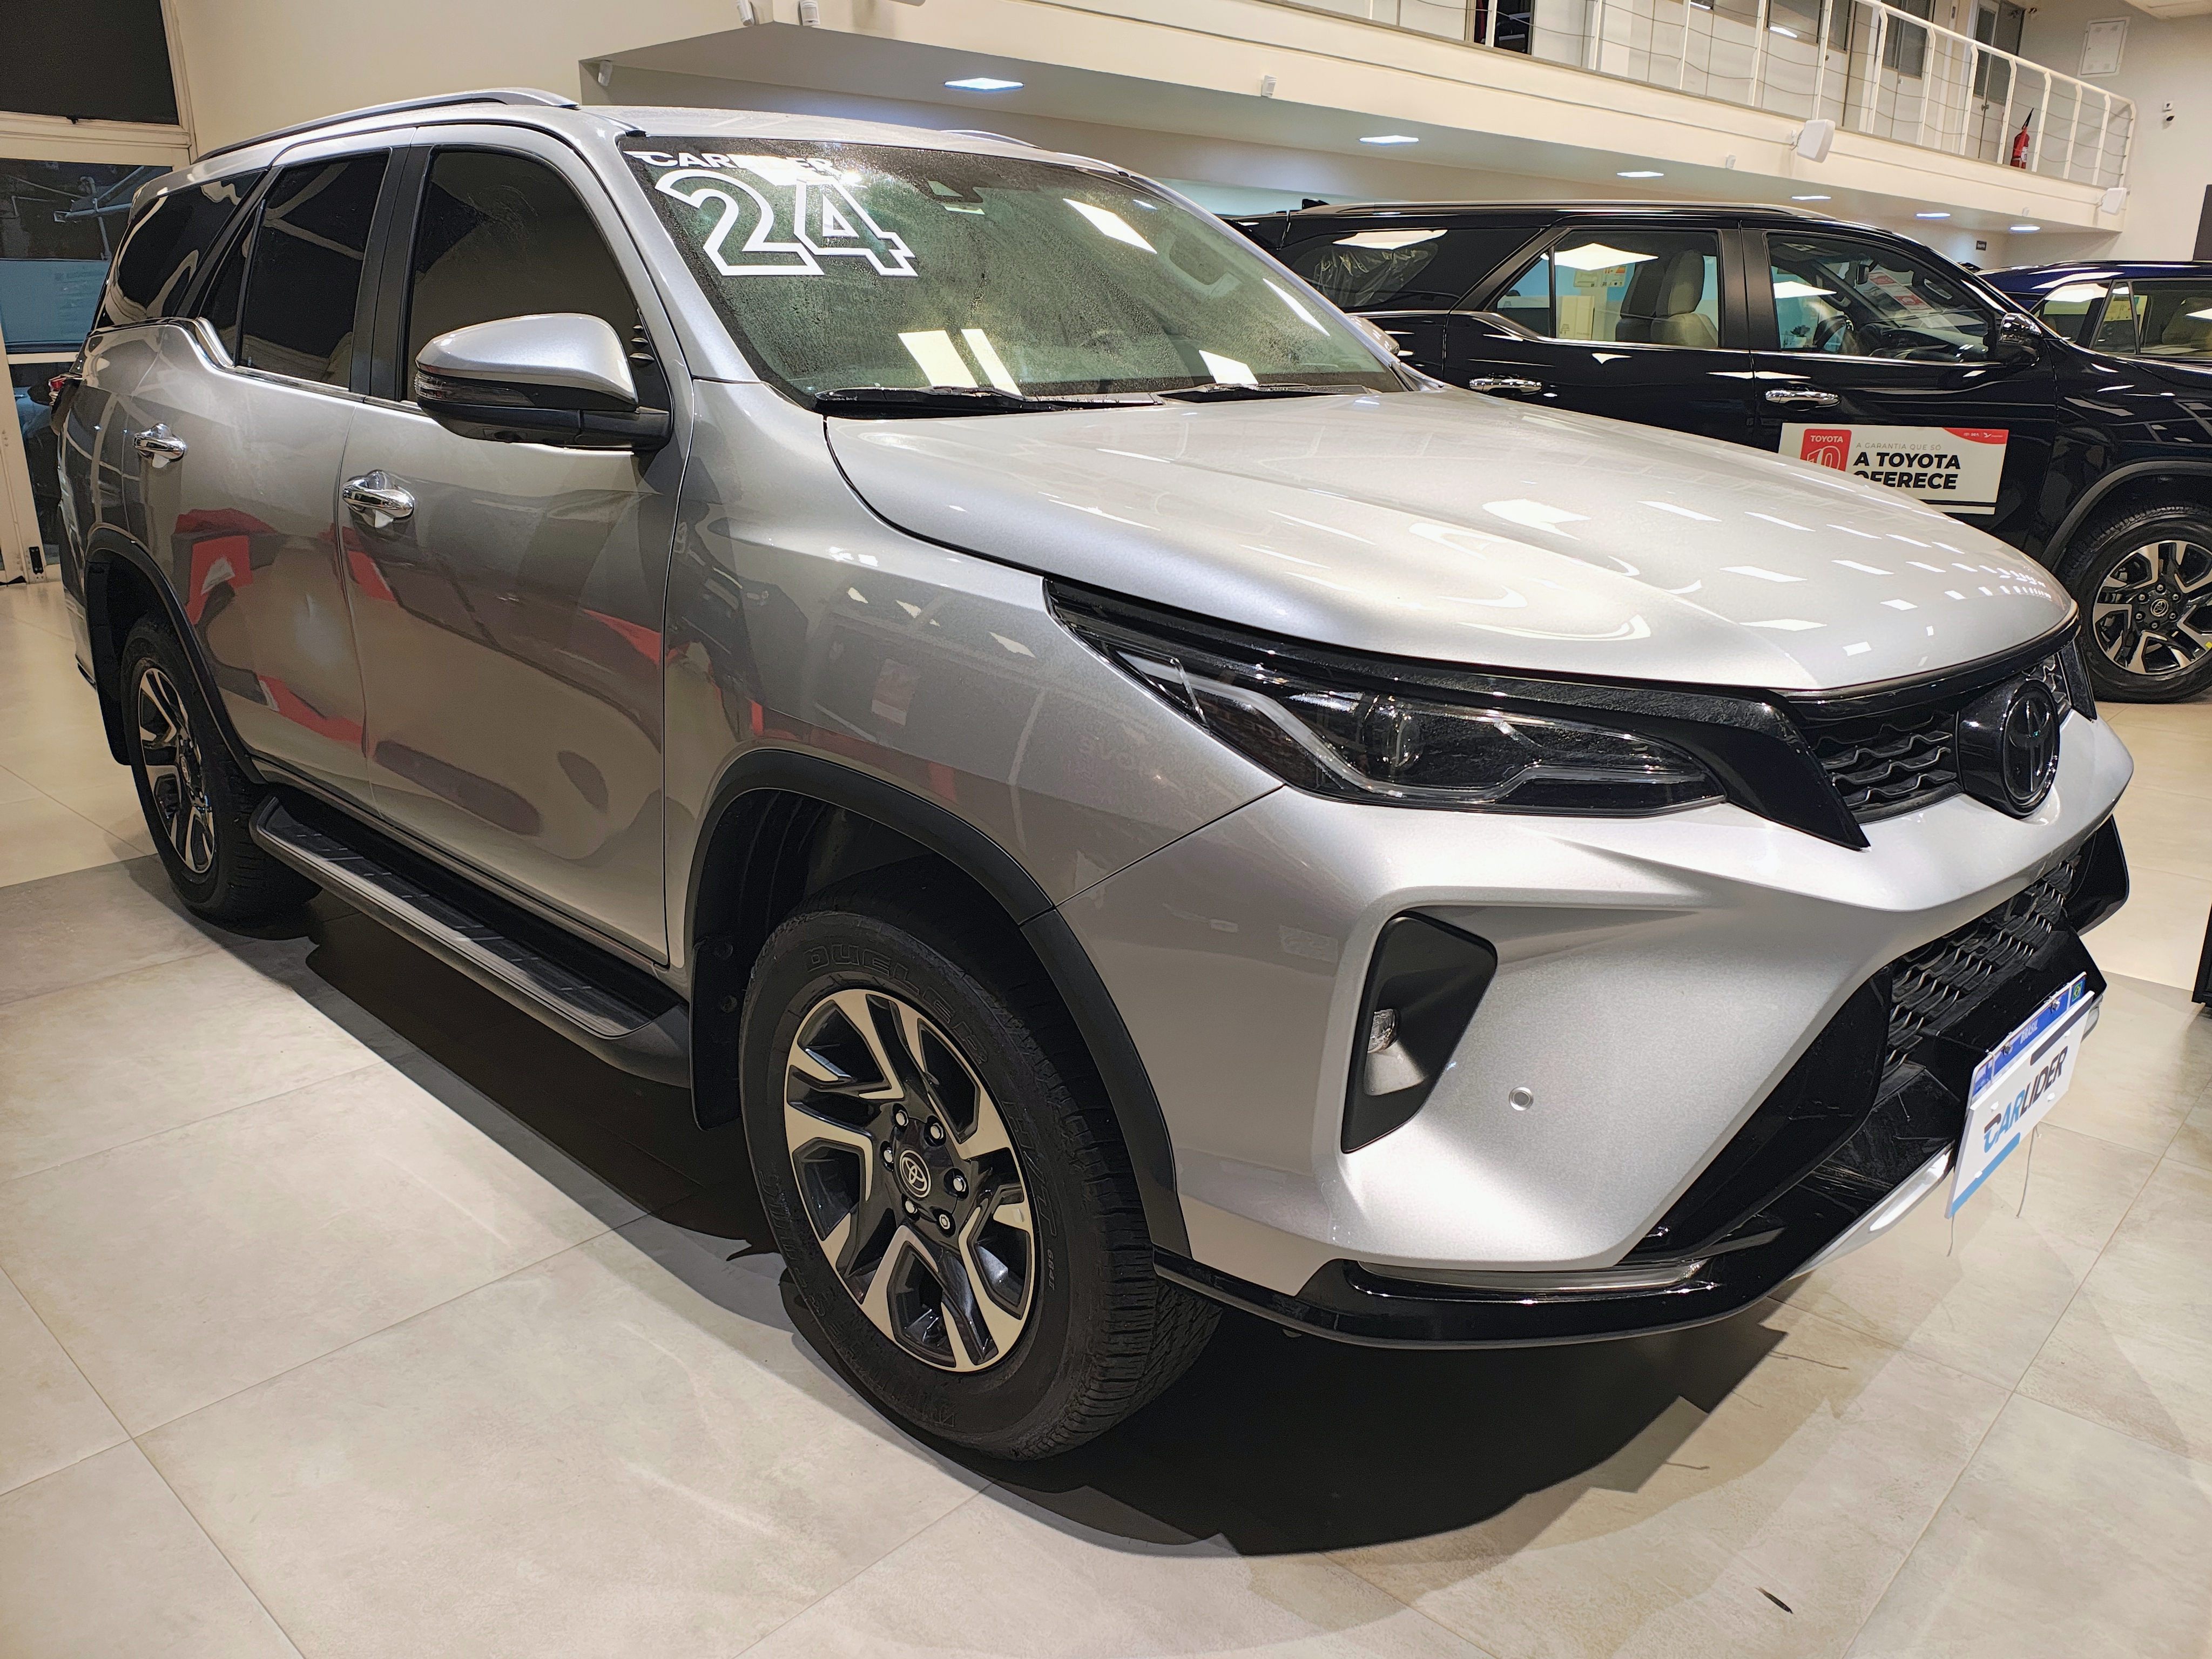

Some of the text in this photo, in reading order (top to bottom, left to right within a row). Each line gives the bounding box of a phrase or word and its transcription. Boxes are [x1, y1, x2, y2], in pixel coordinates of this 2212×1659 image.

[655, 169, 918, 277] 24
[1810, 435, 1843, 443] TOYOTA
[1853, 452, 1961, 470] A TOYOTA
[803, 943, 989, 1065] DUELER
[2020, 1019, 2039, 1044] BRASIL
[1984, 1046, 2068, 1153] CARLIDER
